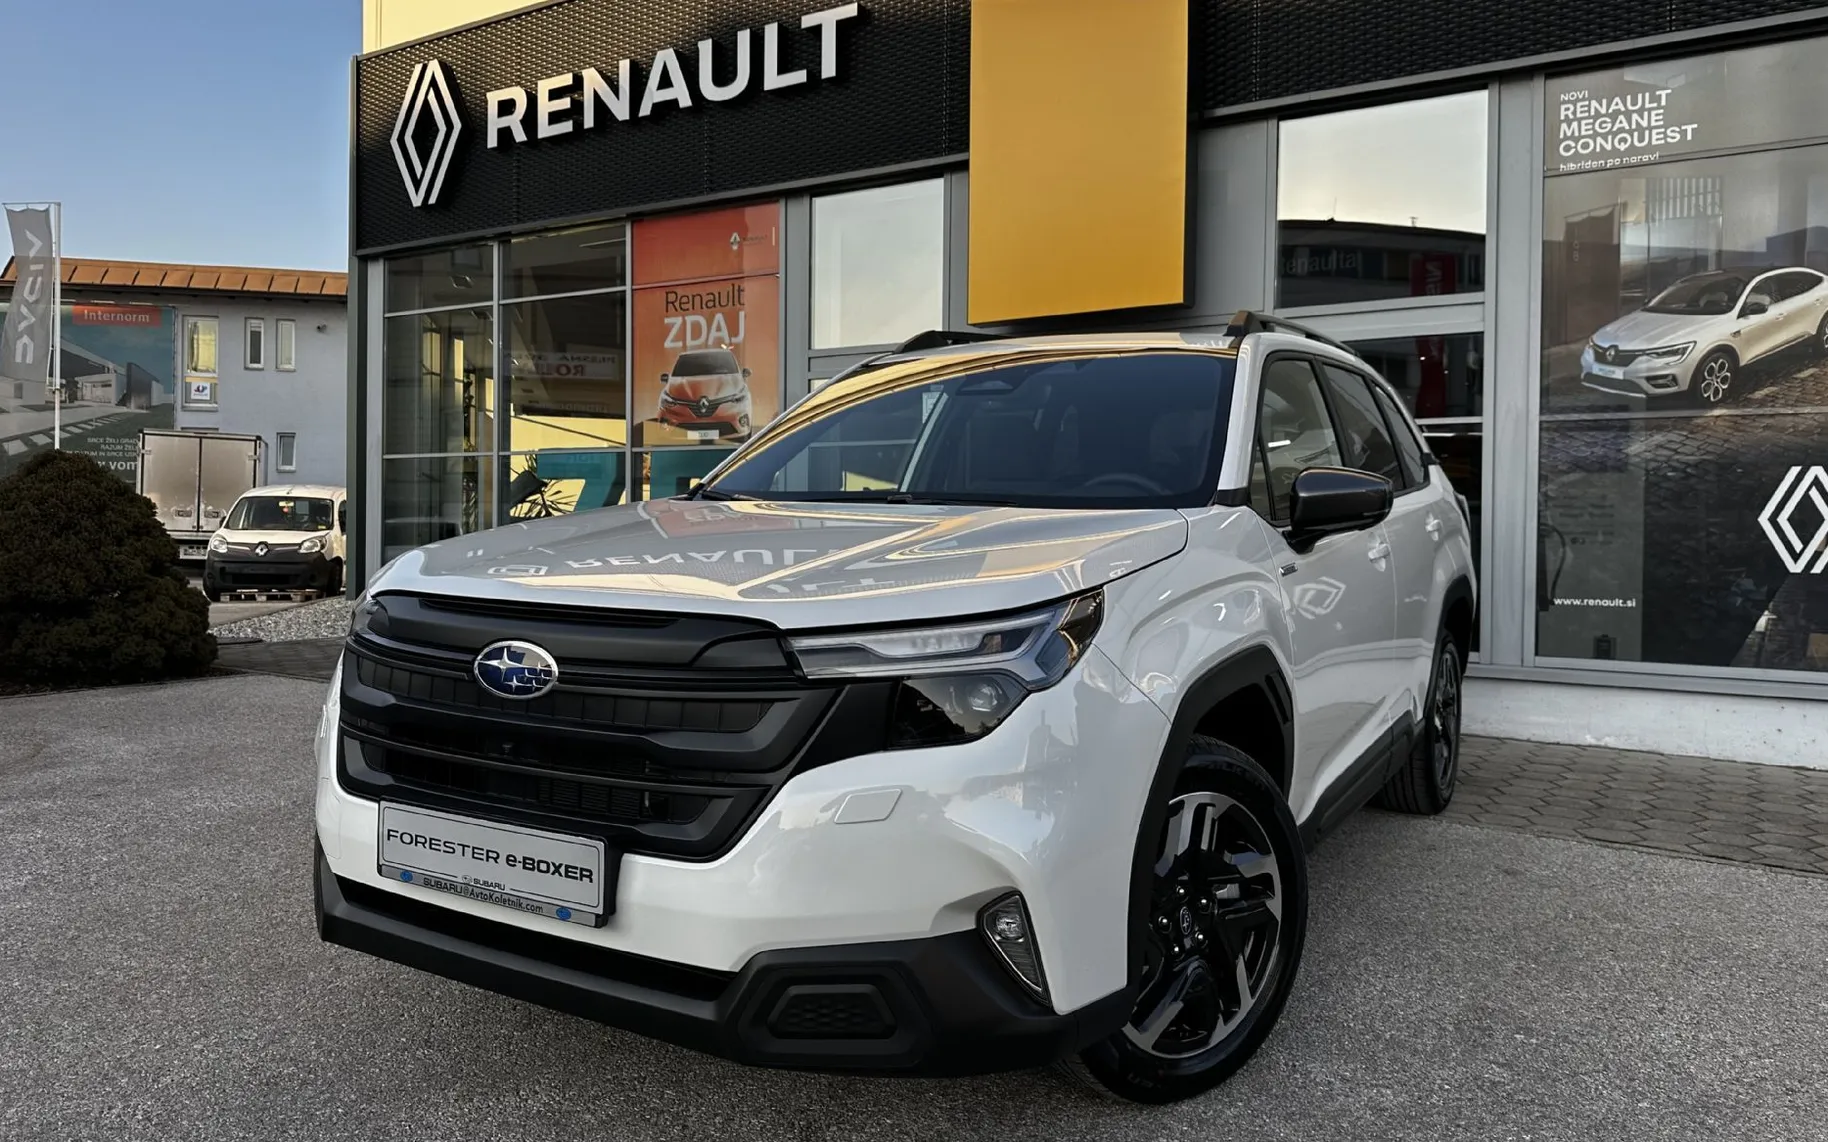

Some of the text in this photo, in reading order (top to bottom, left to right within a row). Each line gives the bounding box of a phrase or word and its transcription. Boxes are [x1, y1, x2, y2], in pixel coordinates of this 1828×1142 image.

[485, 3, 858, 149] RENAULT
[1559, 89, 1672, 120] RENAULT
[1560, 90, 1588, 101] NOVI
[1559, 109, 1664, 139] MEGANE
[1559, 124, 1698, 157] CONQUEST
[1560, 151, 1659, 172] hibriden po naravi
[1282, 248, 1356, 274] enaulta
[664, 284, 746, 313] Renault
[84, 309, 150, 323] Internorm
[663, 312, 746, 349] ZDAJ
[1553, 598, 1636, 608] www.renault.si
[386, 828, 594, 884] FORESTER e-BOXER
[423, 877, 544, 914] SUBARU@AvtoKoletnik.com
[473, 878, 506, 891] SUBARU
